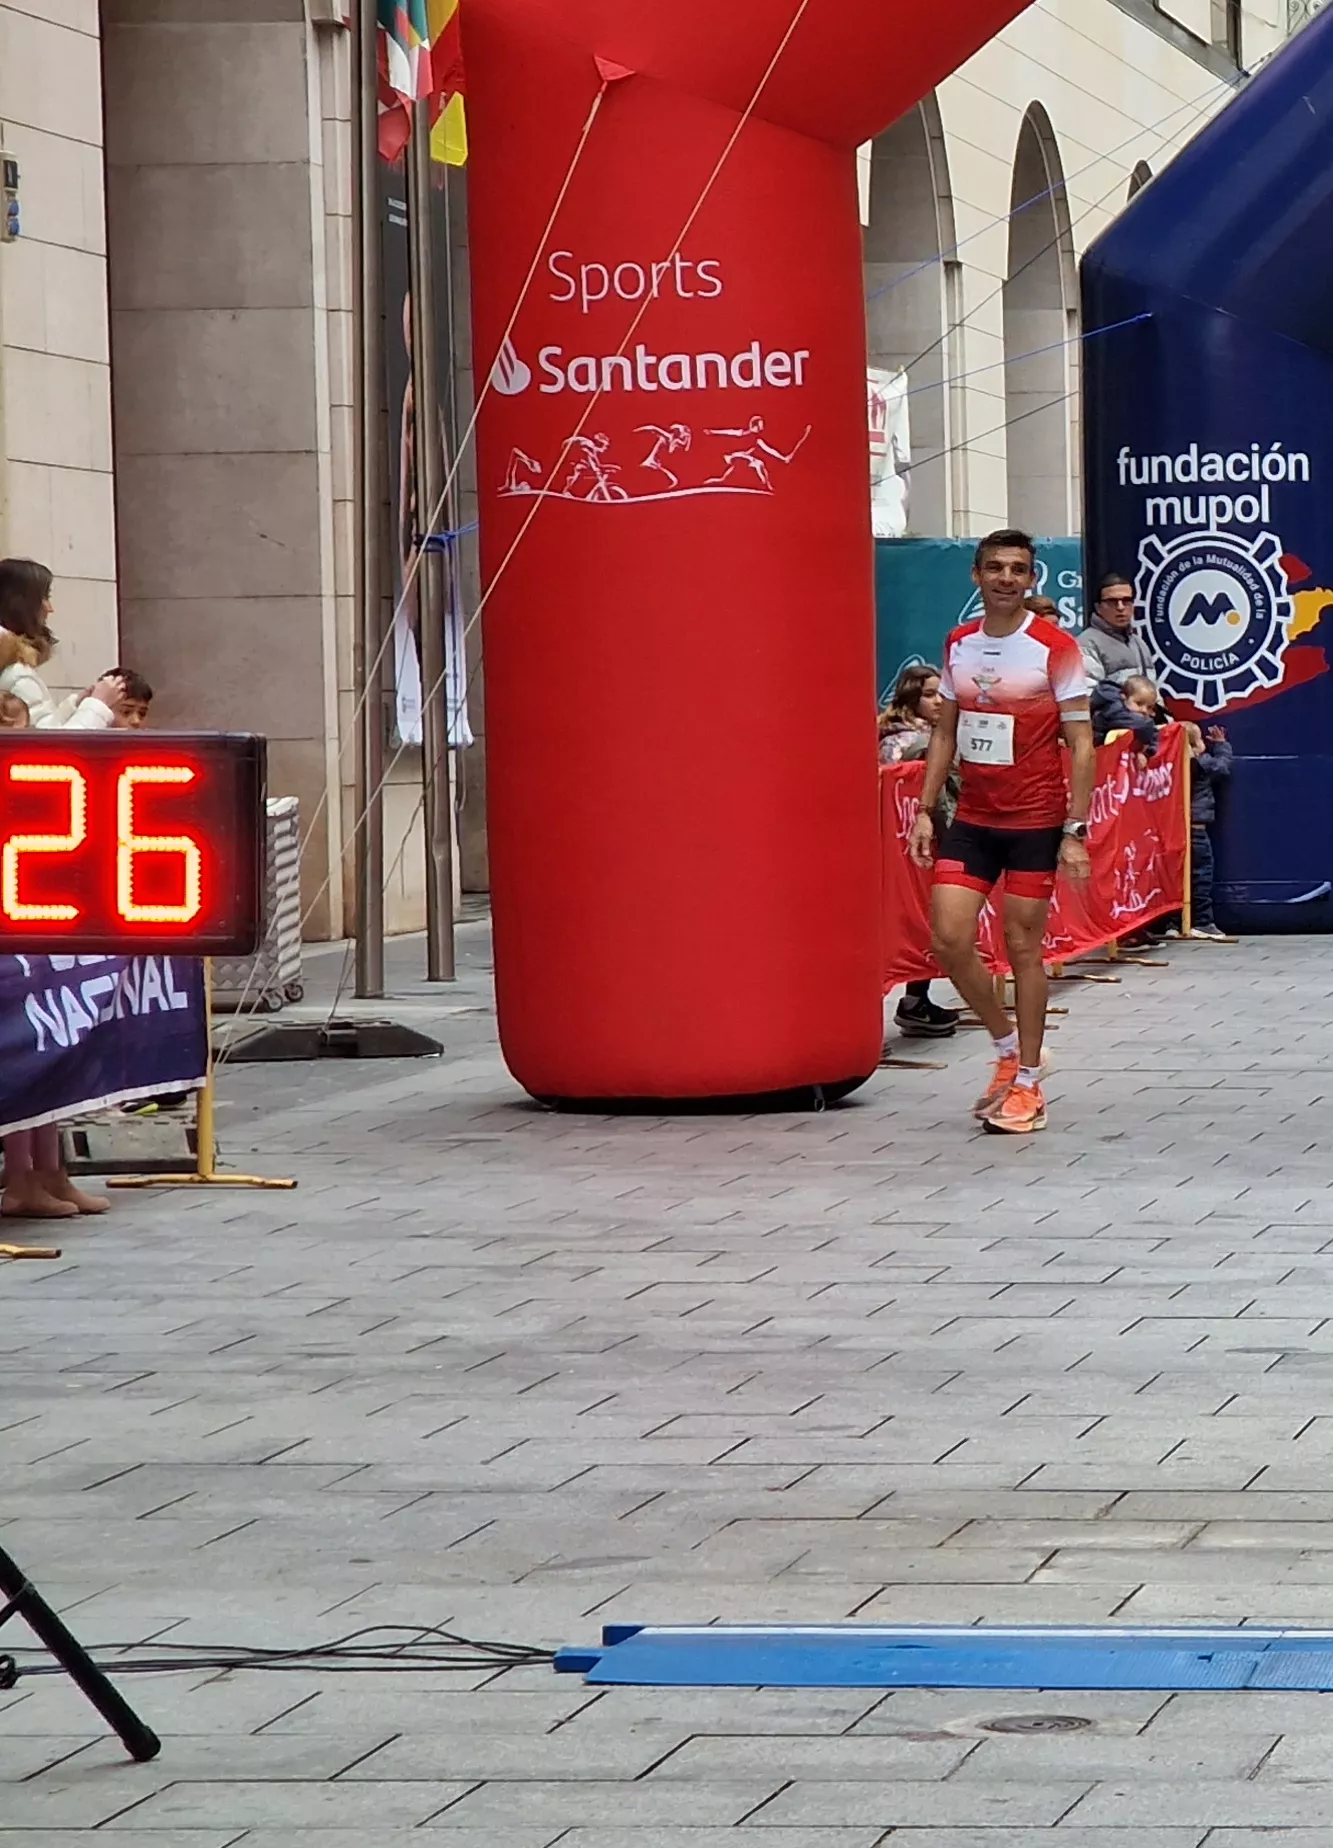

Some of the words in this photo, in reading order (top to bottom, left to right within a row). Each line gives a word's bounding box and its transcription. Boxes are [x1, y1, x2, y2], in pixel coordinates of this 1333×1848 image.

[548, 250, 723, 314] Sports
[538, 341, 810, 394] Santander
[1116, 442, 1311, 485] fundación
[1146, 483, 1270, 531] mupol
[1178, 561, 1192, 572] de
[1192, 555, 1203, 565] la
[1254, 592, 1264, 607] de
[1256, 608, 1267, 620] la
[1180, 652, 1241, 671] POLICÍA
[970, 738, 993, 752] 577
[3, 764, 202, 923] 26
